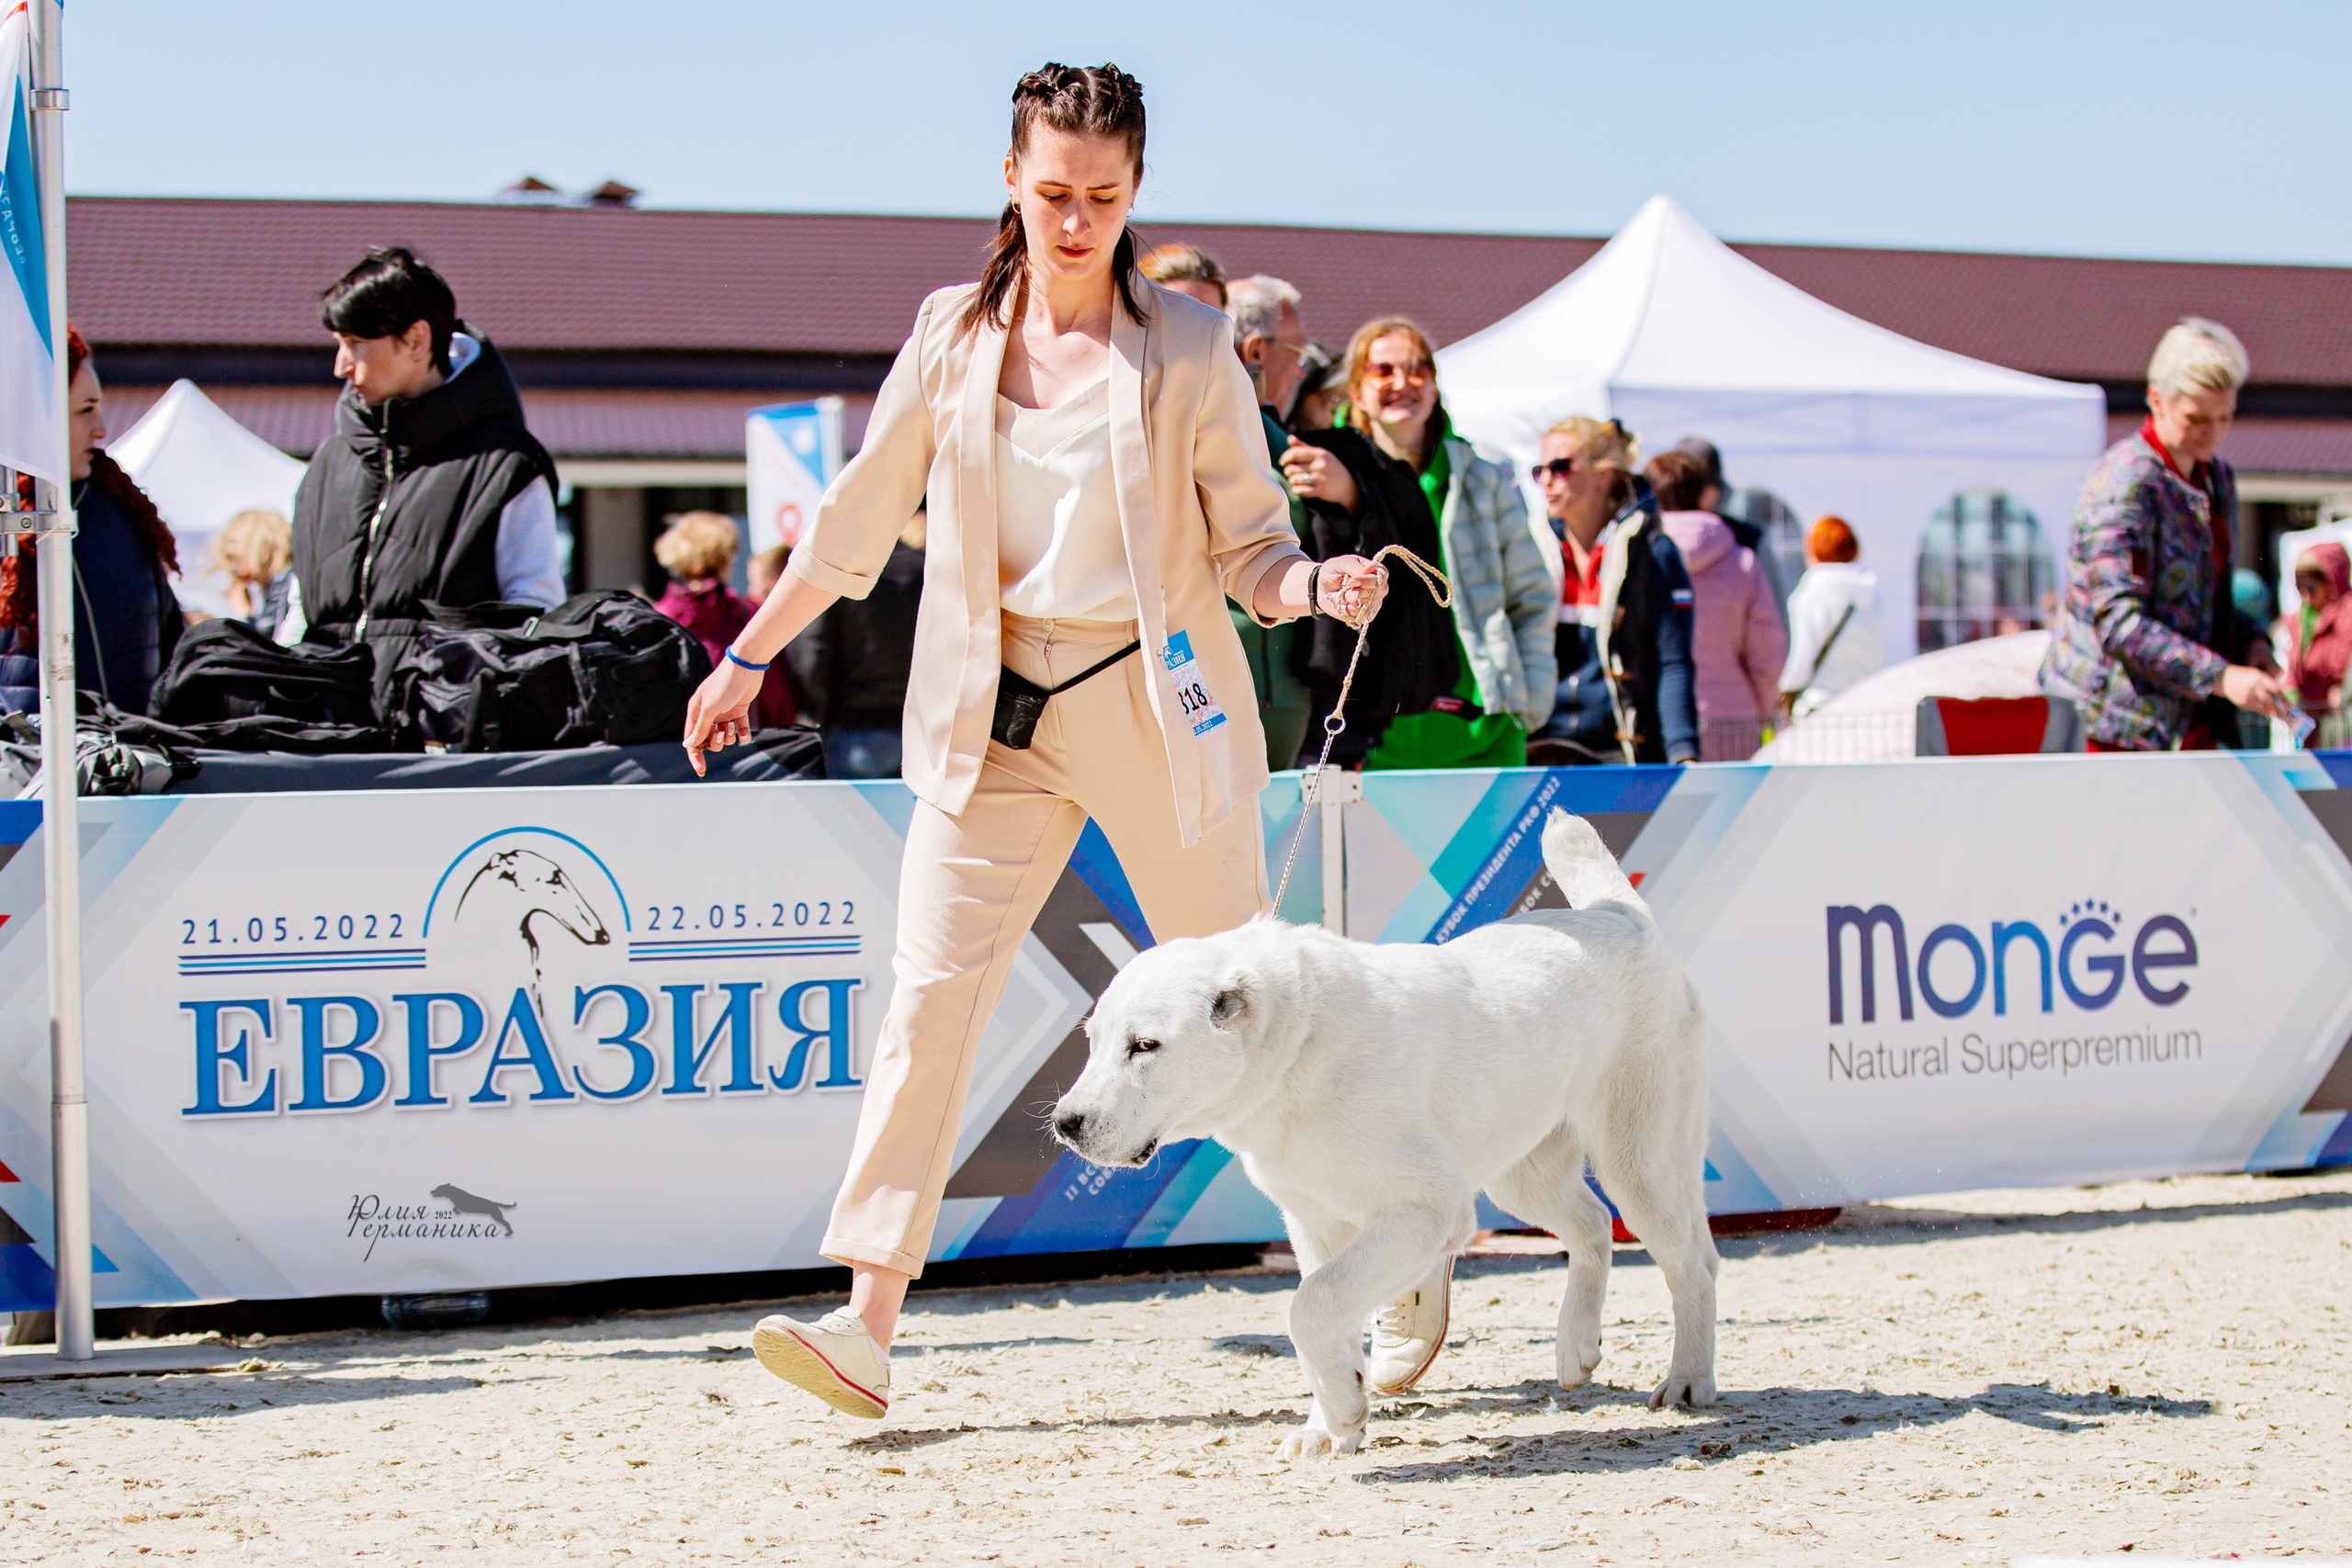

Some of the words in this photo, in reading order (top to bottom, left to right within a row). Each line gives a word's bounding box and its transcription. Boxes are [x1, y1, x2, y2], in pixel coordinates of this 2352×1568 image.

[1435, 903, 1469, 944] КУБОК
[1464, 831, 1522, 905] ПРЕЗИДЕНТА
[1518, 805, 1541, 834] РКФ
[1536, 775, 1561, 808] 2022
[647, 900, 854, 931] 22.05.2022
[1516, 886, 1543, 914] БОК
[182, 913, 402, 945] 21.05.2022
[178, 977, 864, 1118] ЕВРАЗИЯ
[1828, 1038, 1949, 1081] Natural
[1961, 1025, 2202, 1080] Superpremium
